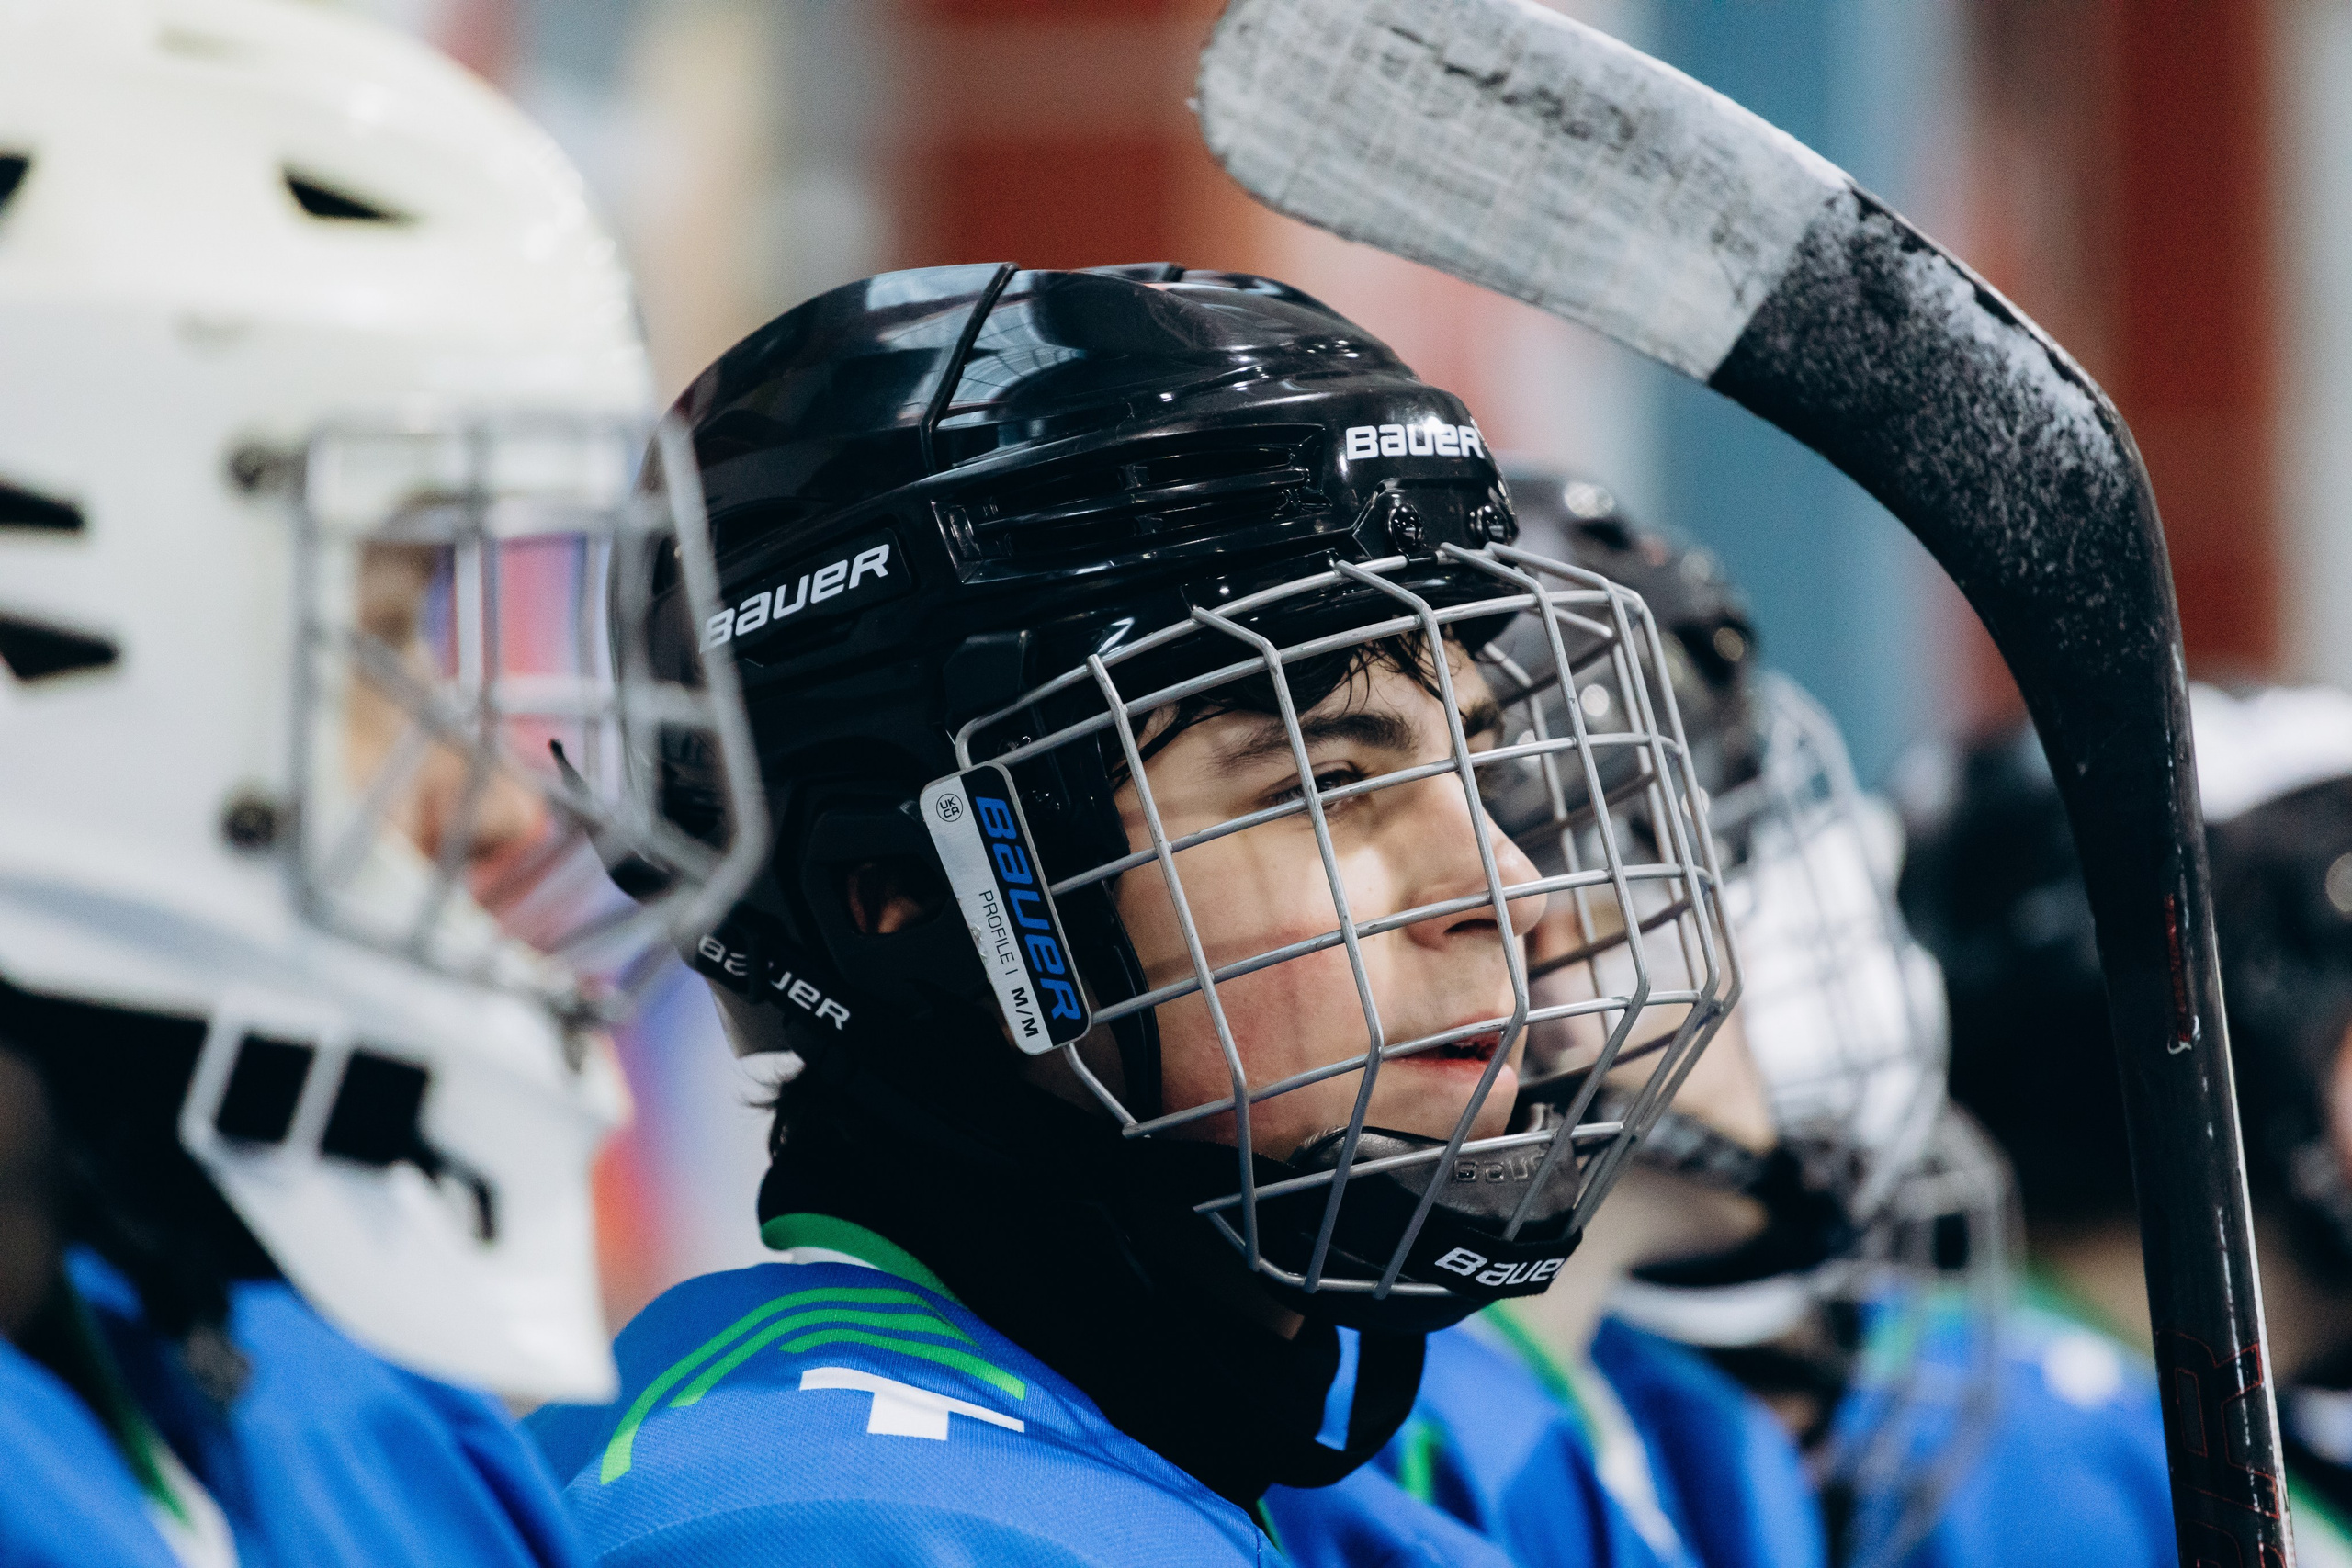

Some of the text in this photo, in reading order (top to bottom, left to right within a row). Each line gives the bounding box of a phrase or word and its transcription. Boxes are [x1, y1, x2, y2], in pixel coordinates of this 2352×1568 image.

[939, 796, 956, 810] UK
[943, 806, 960, 818] CA
[978, 889, 1015, 964] PROFILE
[1011, 986, 1040, 1038] M/M
[1434, 1247, 1566, 1286] BAUE
